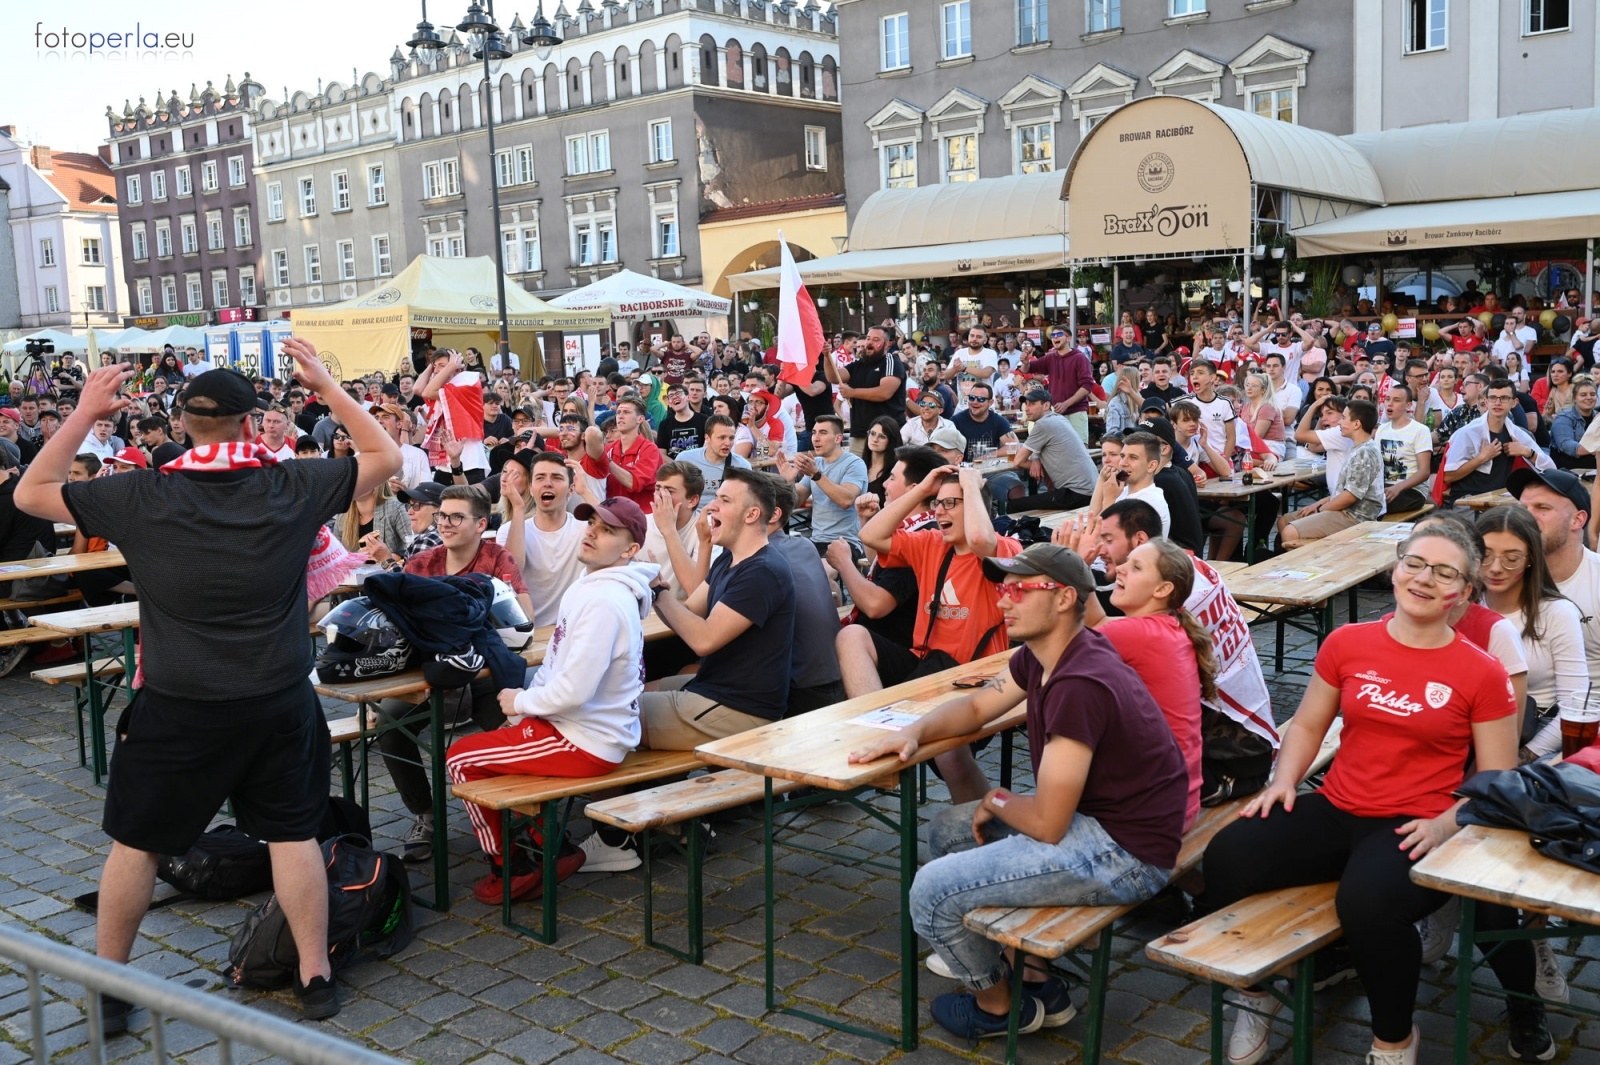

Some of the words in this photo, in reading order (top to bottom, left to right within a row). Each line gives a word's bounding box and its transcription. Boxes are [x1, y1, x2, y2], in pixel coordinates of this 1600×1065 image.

[1119, 131, 1151, 142] BROWAR
[1155, 125, 1194, 138] RACIBÓRZ
[1474, 228, 1502, 236] Racibórz
[620, 298, 684, 313] RACIBORSKIE
[696, 298, 728, 311] RACIBORSKIE
[166, 314, 200, 327] KANTOR
[295, 319, 317, 327] BROWAR
[317, 319, 344, 327] RACIBÓRZ
[351, 317, 375, 326] BROWAR
[375, 314, 403, 324] RACIBÓRZ
[413, 314, 443, 324] BROWAR
[444, 315, 477, 326] RACIBÓRZ
[487, 318, 513, 326] BROAR
[514, 318, 544, 326] RACIBÓRZ
[552, 318, 577, 326] BROWAR
[1356, 683, 1423, 713] Polska
